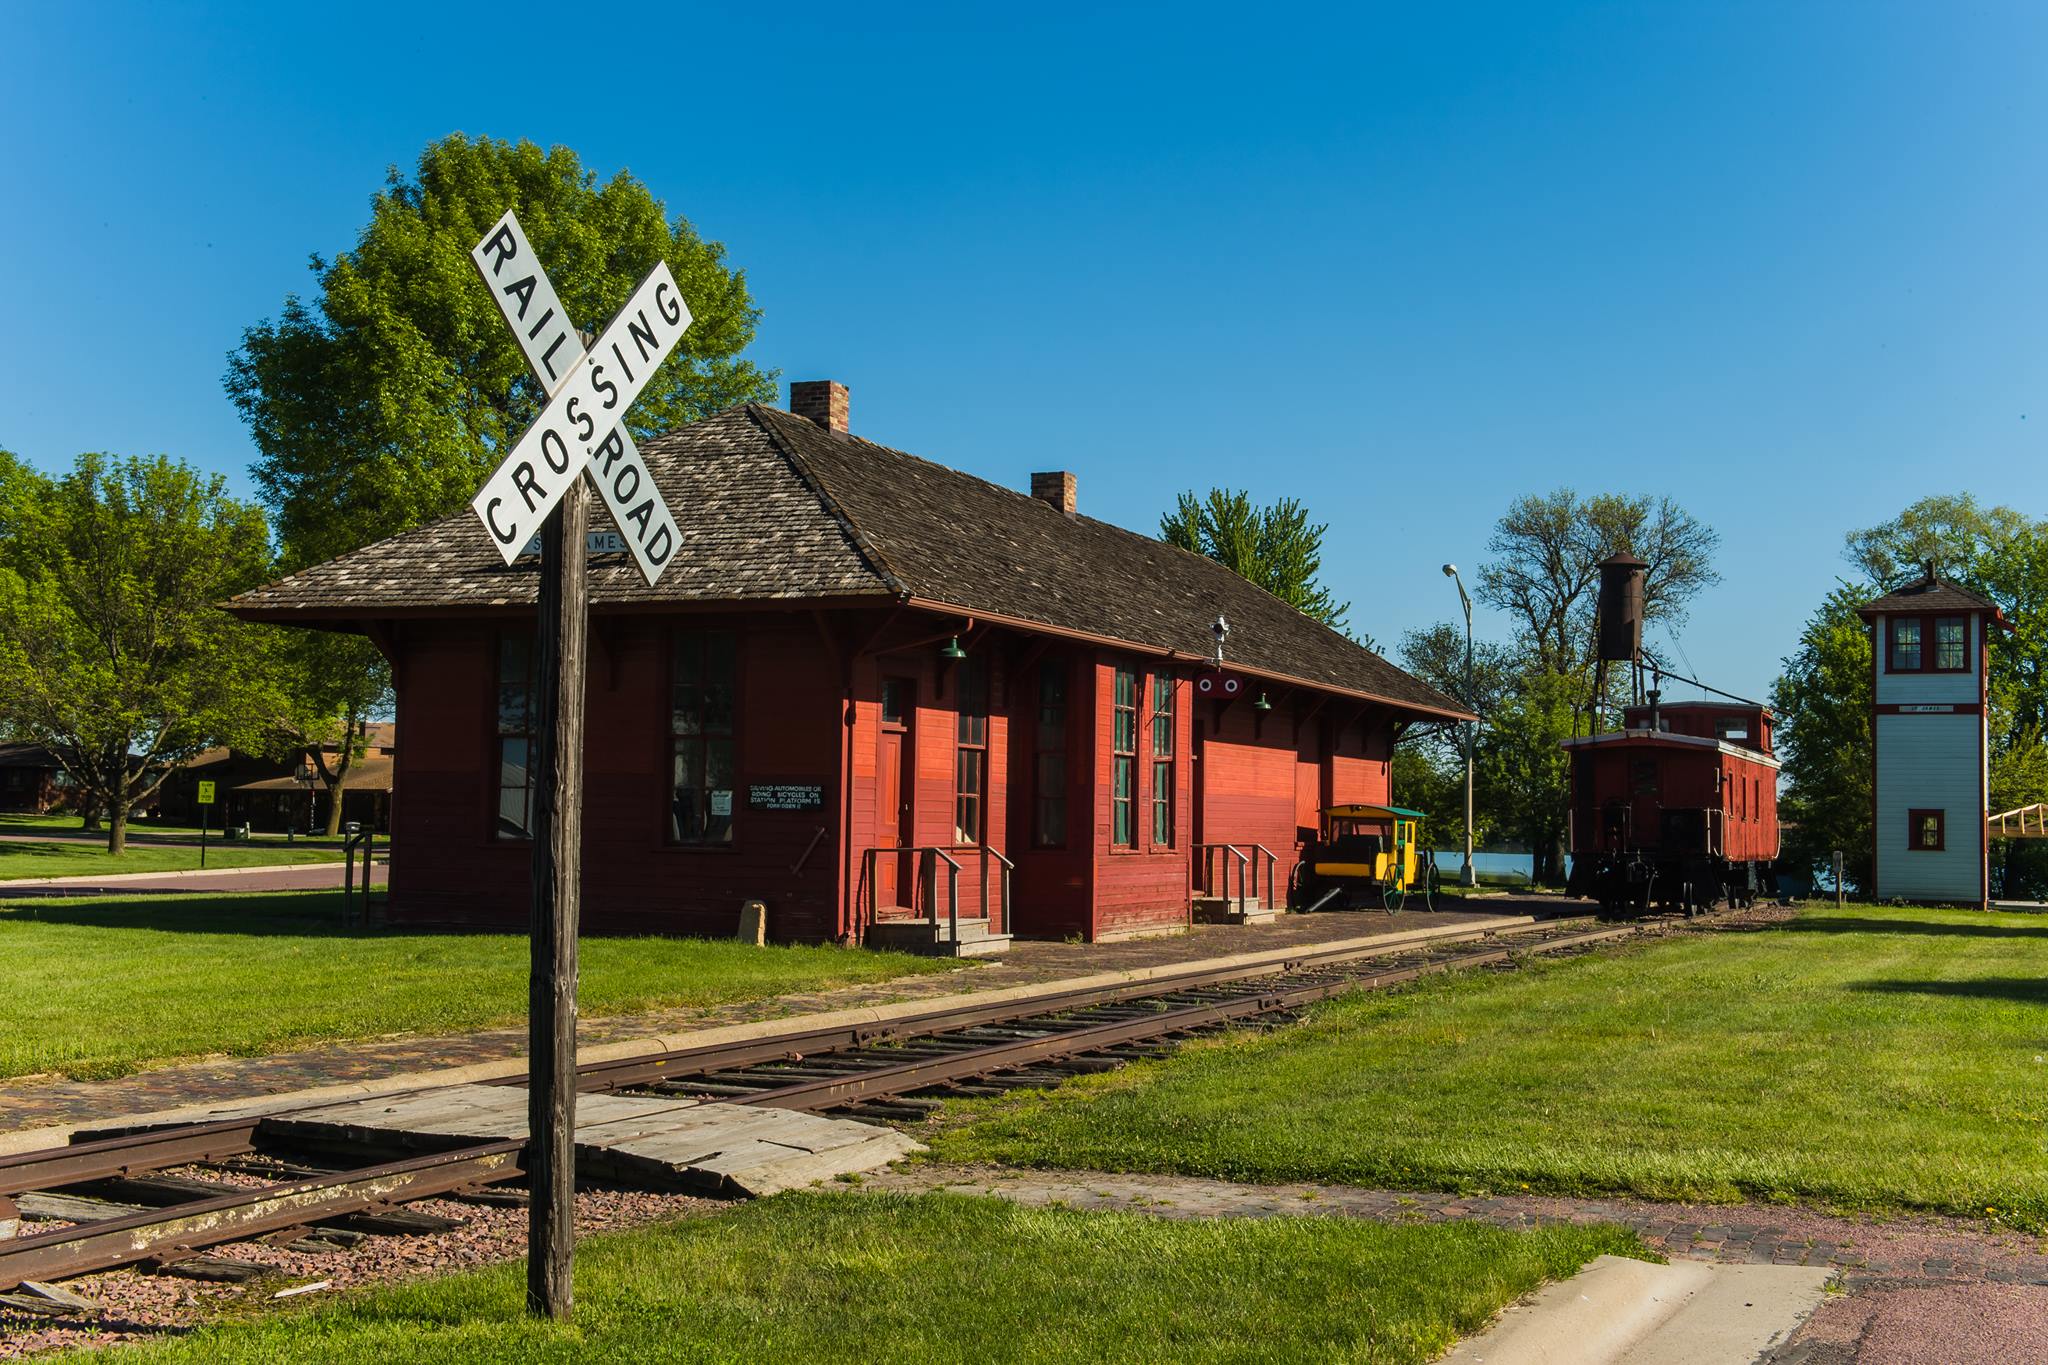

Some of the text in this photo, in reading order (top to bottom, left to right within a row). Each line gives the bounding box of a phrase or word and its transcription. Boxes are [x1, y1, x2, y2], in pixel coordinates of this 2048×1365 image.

[482, 223, 673, 566] RAIL ROAD
[486, 282, 681, 545] CROSSING
